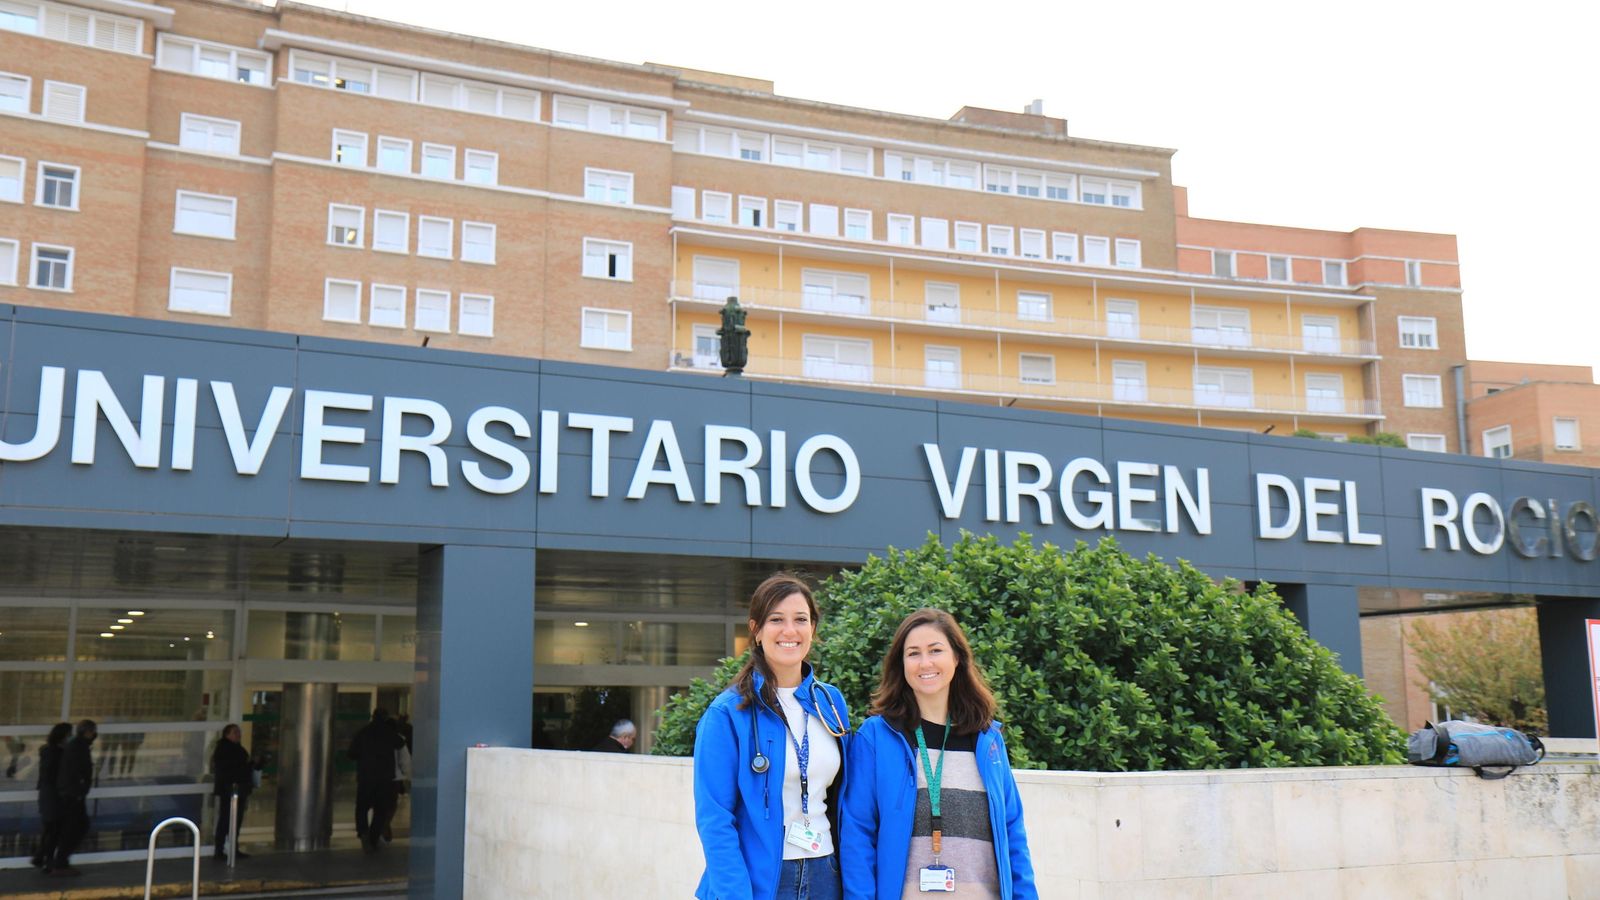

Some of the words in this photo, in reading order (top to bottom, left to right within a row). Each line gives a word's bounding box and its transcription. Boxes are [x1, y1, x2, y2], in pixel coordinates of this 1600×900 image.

[0, 366, 861, 514] UNIVERSITARIO
[923, 442, 1212, 536] VIRGEN
[1256, 472, 1382, 545] DEL
[1421, 487, 1600, 562] ROCIO
